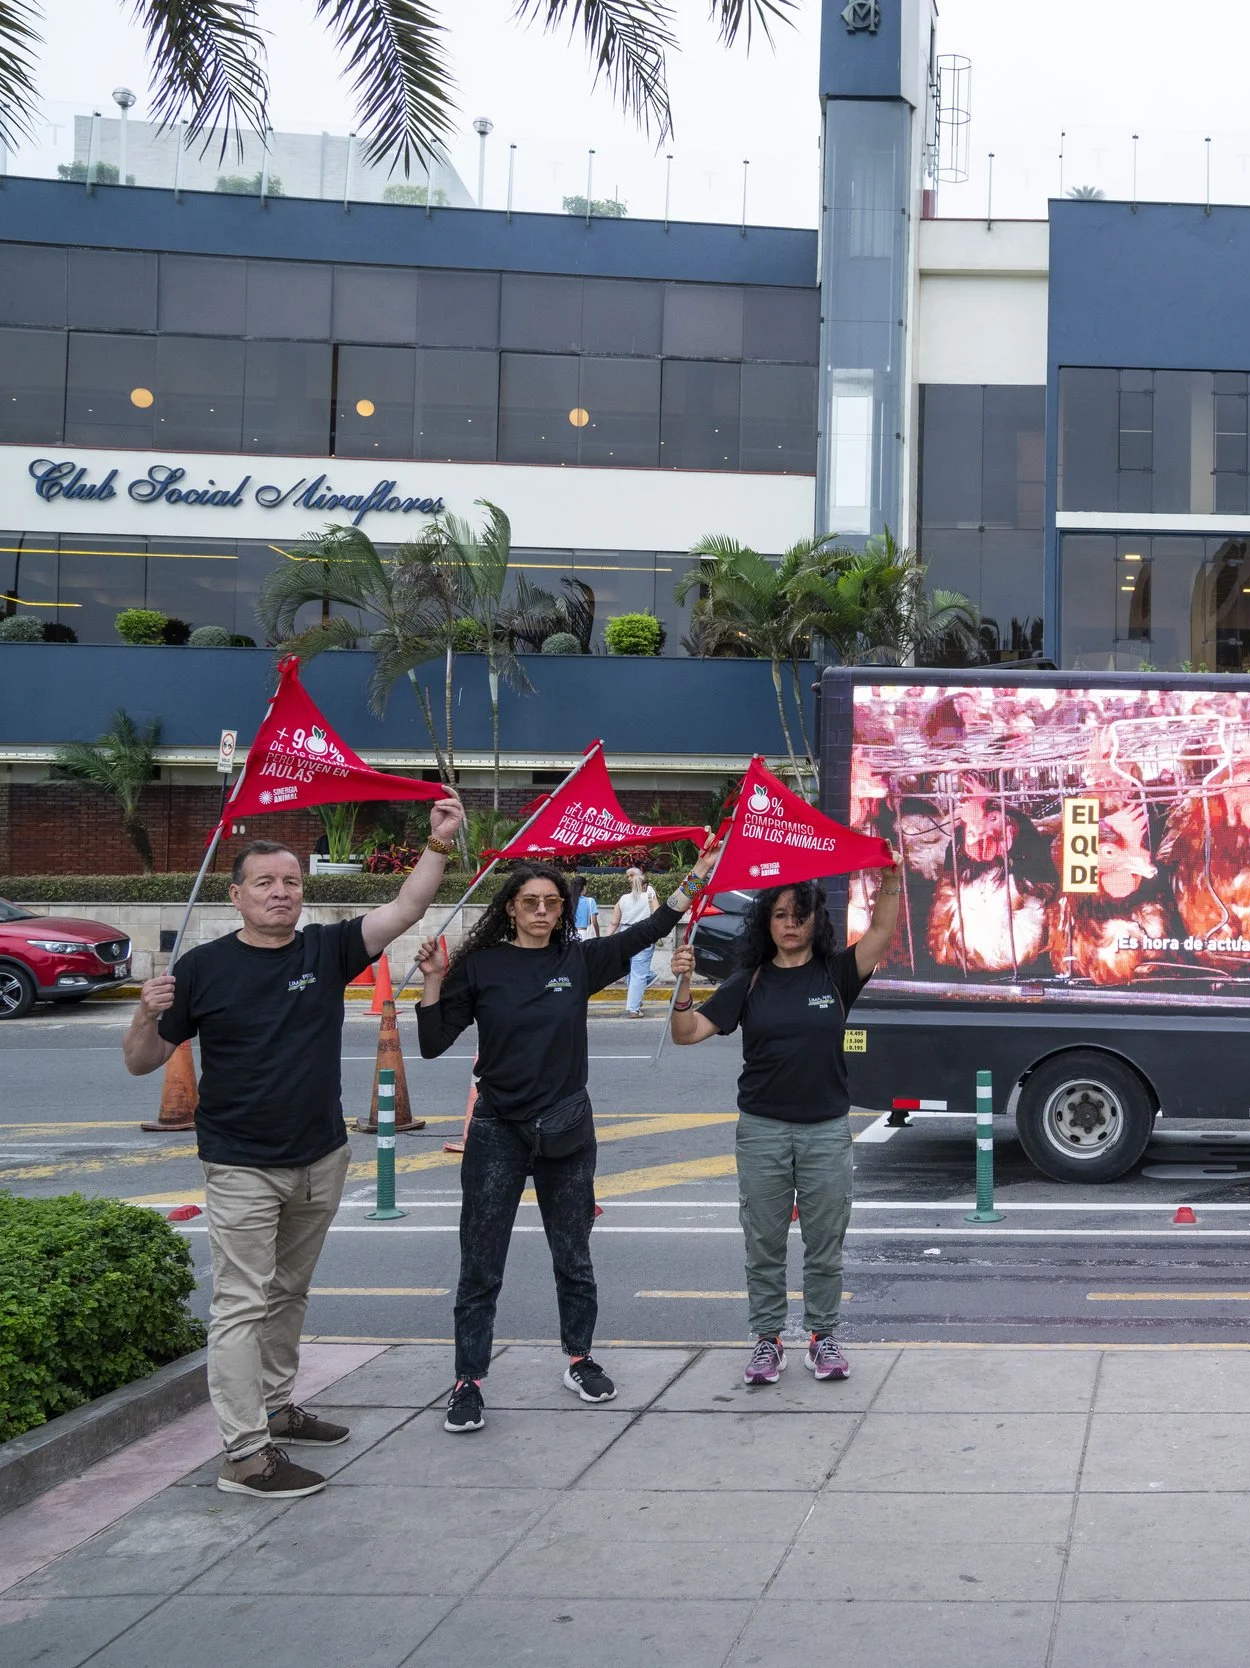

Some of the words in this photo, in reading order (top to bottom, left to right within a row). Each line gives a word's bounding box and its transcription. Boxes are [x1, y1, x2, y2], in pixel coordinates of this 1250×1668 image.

[28, 458, 119, 503] Club
[127, 464, 253, 508] Social
[254, 473, 448, 526] Miraflores
[269, 740, 284, 753] DE
[259, 762, 316, 783] JAULAS
[296, 757, 332, 774] VIVEN
[332, 766, 350, 778] EN
[273, 785, 298, 796] SINERGIA
[274, 793, 298, 804] ANIMAL
[577, 808, 597, 823] LAS
[595, 814, 636, 836] GALLINAS
[635, 826, 653, 837] DEL
[745, 813, 814, 836] COMPROMISO
[1072, 805, 1099, 824] EL
[550, 827, 596, 848] JAULAS
[582, 824, 610, 841] VIVEN
[742, 823, 765, 839] CON
[764, 828, 784, 843] LOS
[784, 832, 836, 852] ANIMALES
[1070, 866, 1098, 885] DE
[1143, 936, 1179, 950] hora
[1184, 936, 1203, 950] de
